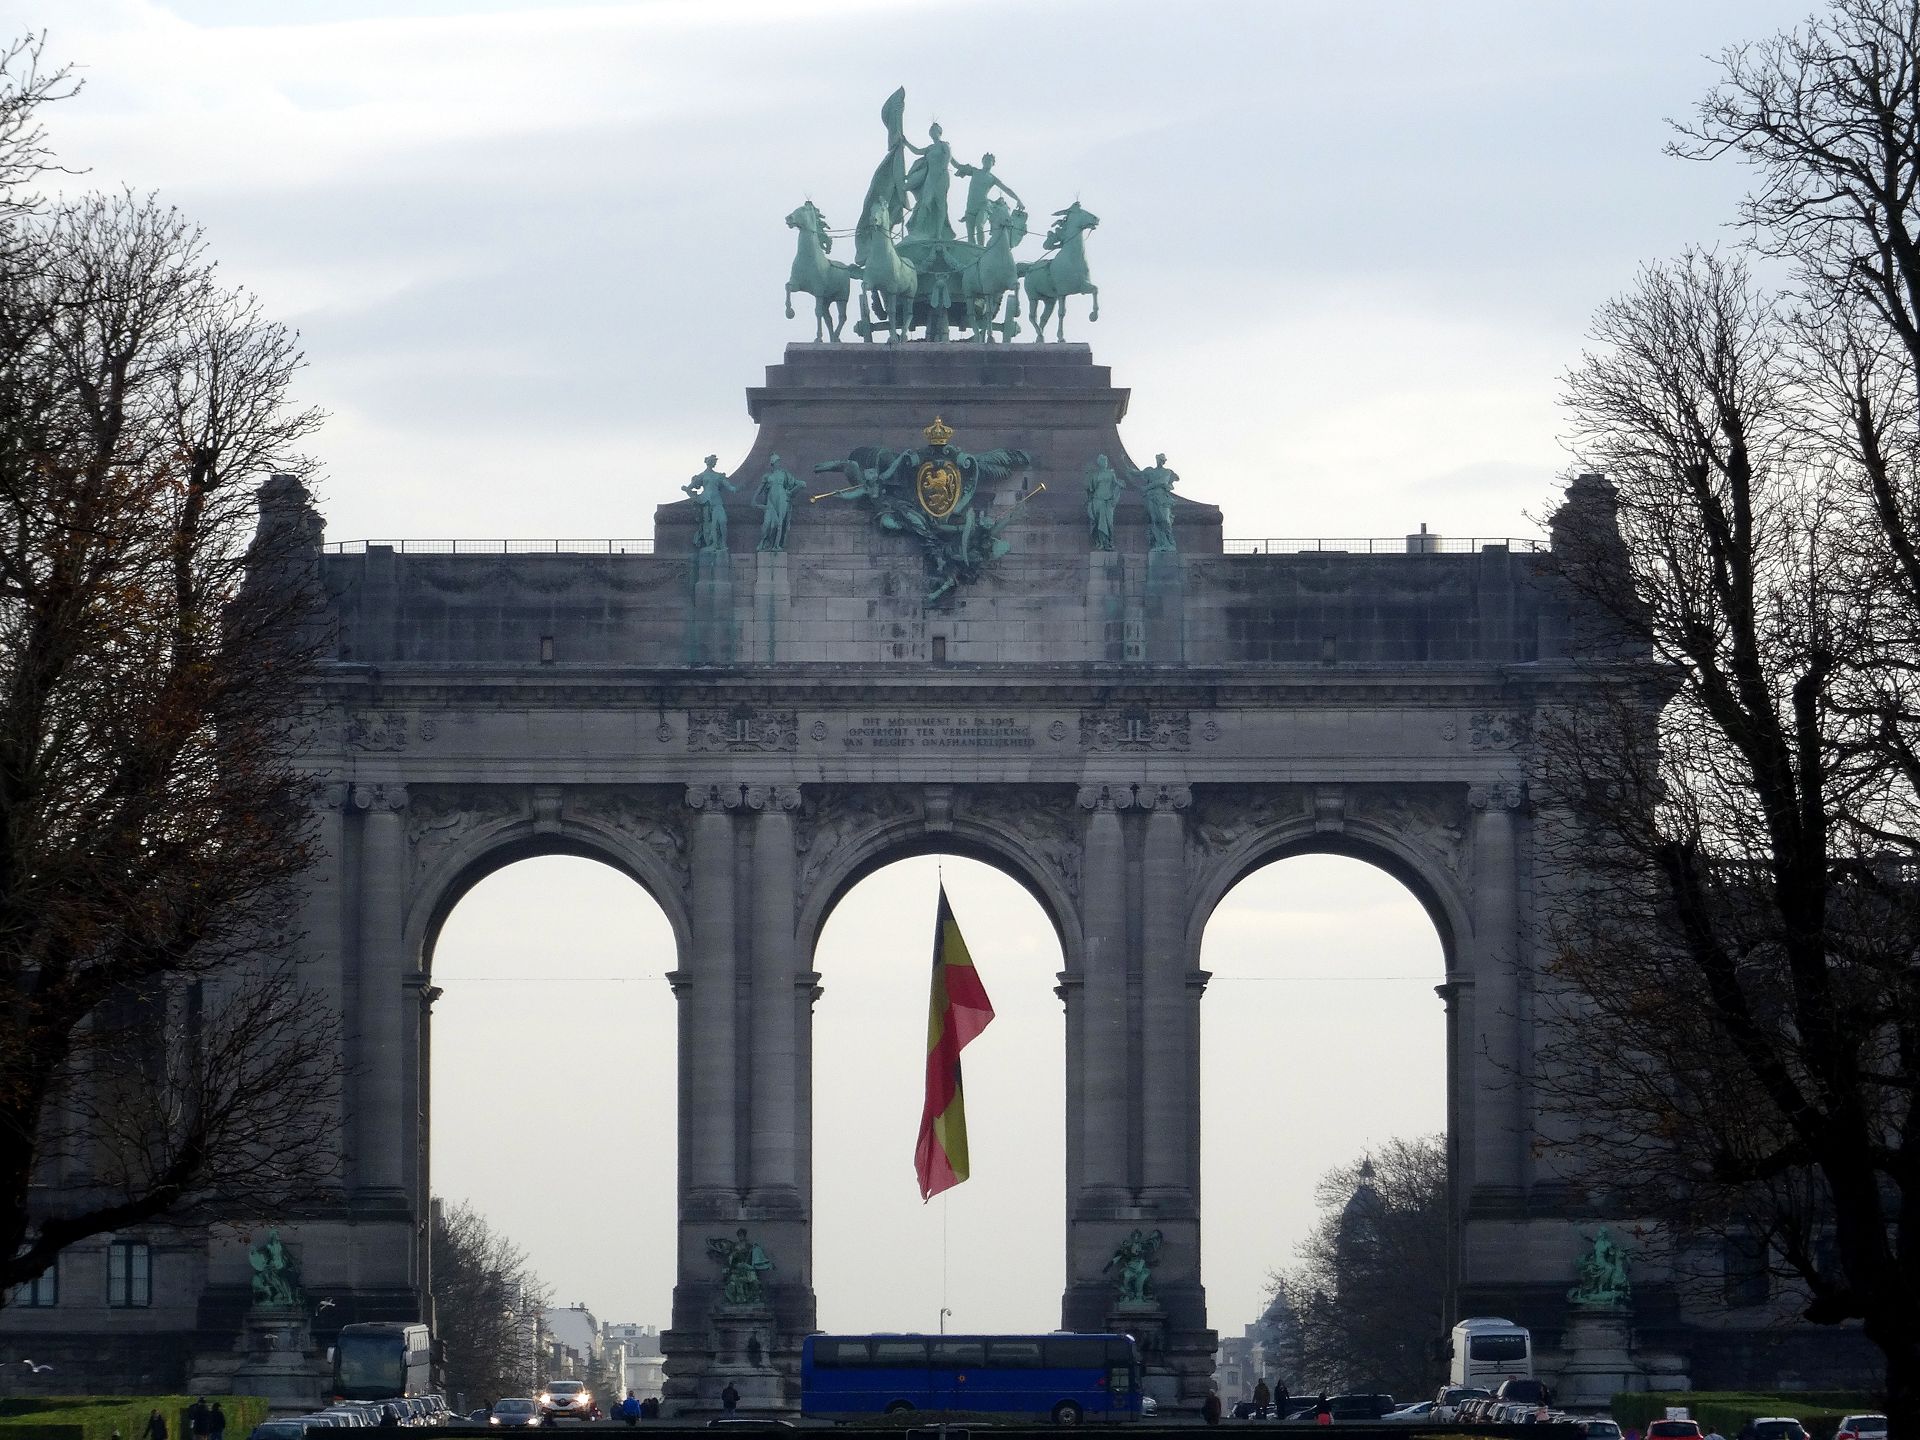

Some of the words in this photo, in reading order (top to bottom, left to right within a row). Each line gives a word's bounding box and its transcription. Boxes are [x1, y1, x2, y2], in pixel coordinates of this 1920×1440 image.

[862, 718, 880, 727] DIT
[888, 718, 950, 727] MONUMENT
[958, 718, 968, 727] IS
[990, 718, 1014, 727] 1905
[849, 728, 909, 736] OPGERICHT
[916, 728, 935, 737] TER
[841, 738, 863, 747] VAN
